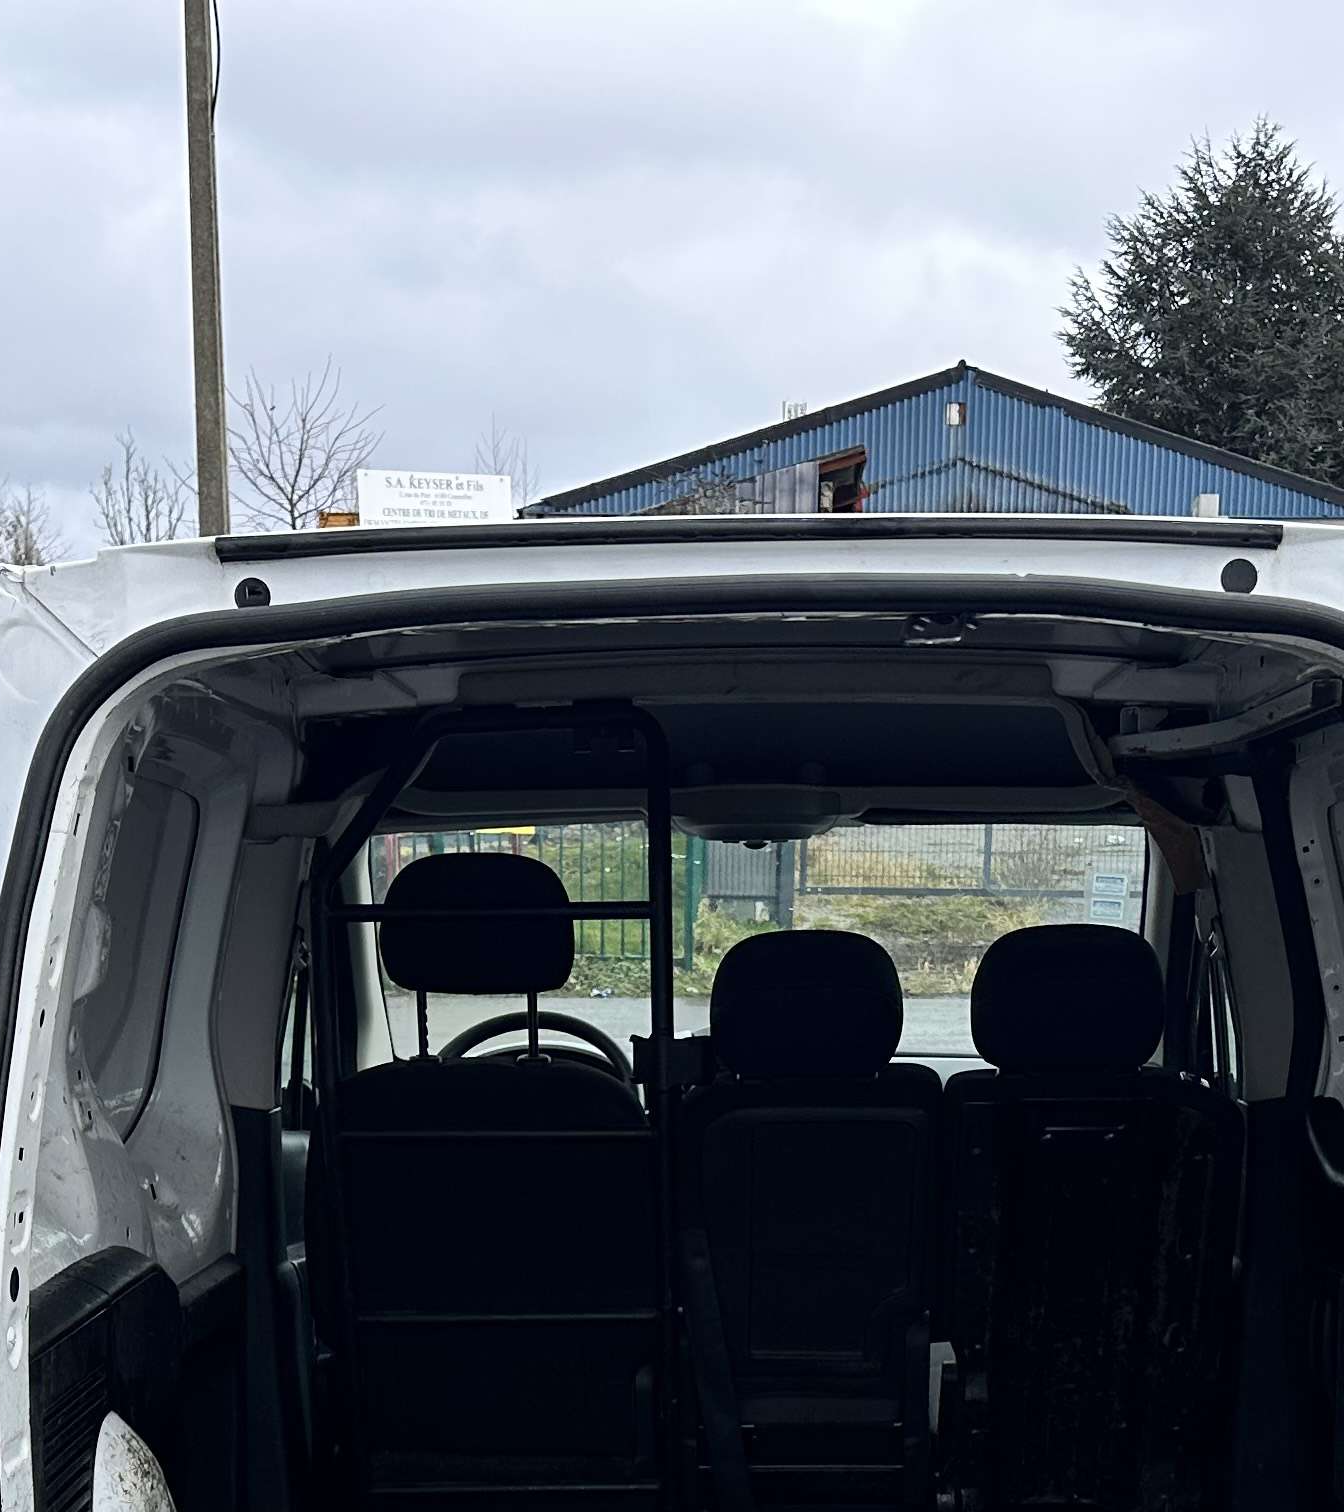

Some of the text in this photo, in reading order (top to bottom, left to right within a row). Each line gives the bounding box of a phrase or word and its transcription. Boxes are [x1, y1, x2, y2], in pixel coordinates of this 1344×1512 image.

[409, 478, 453, 491] KEYSER
[456, 481, 464, 491] et
[467, 480, 484, 492] Fils
